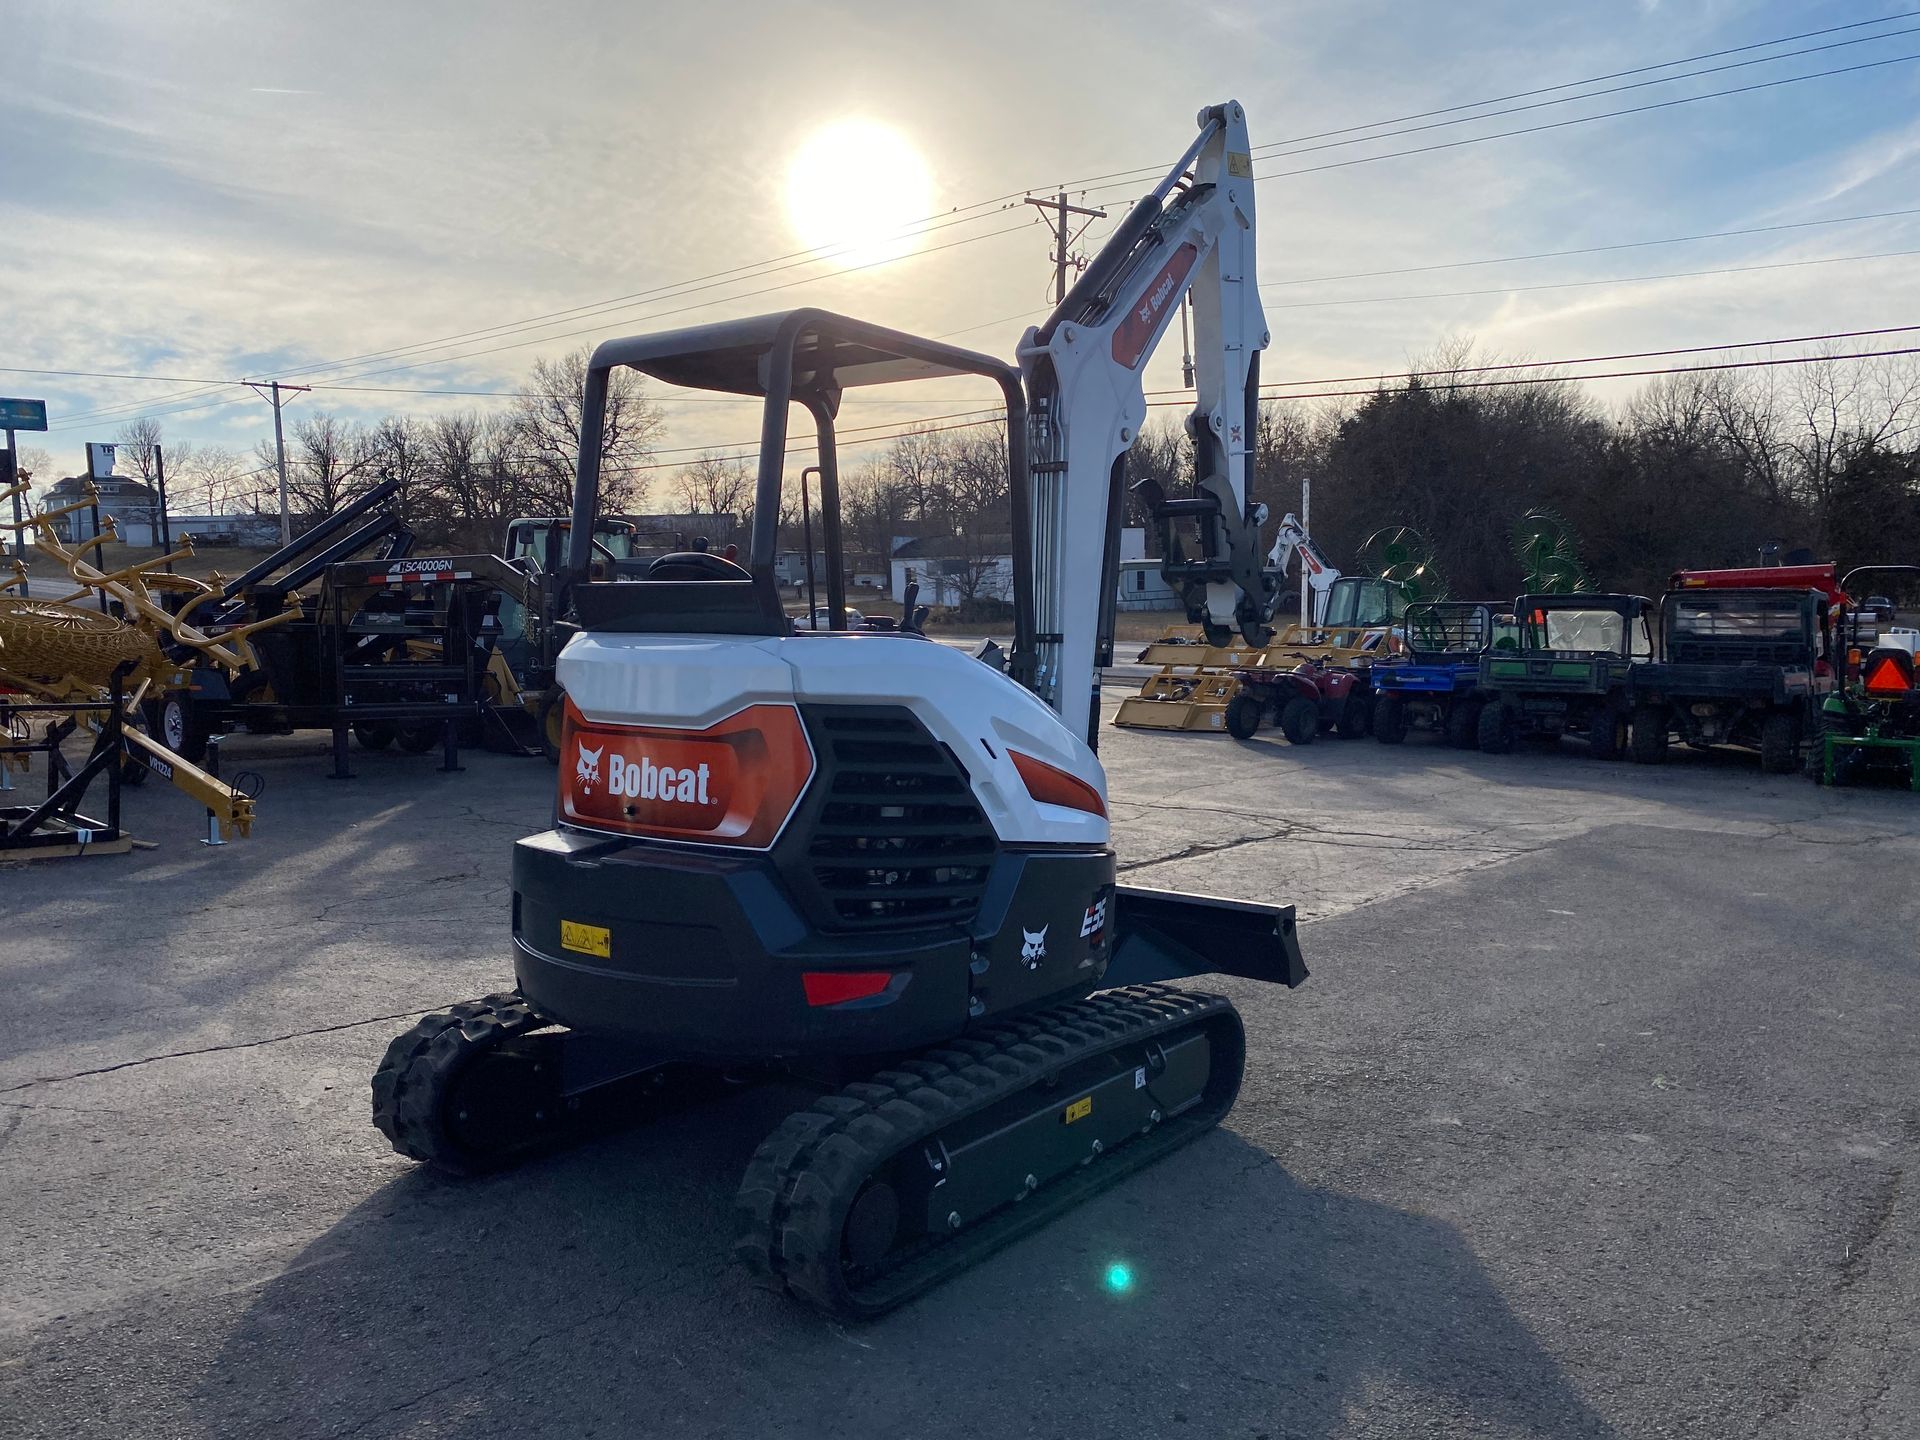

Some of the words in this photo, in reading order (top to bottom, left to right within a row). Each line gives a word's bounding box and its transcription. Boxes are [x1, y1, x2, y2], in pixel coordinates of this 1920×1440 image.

[1150, 272, 1175, 312] Bobcat
[149, 755, 172, 778] VR1224
[608, 753, 710, 805] Bobcat
[1079, 896, 1107, 938] E35
